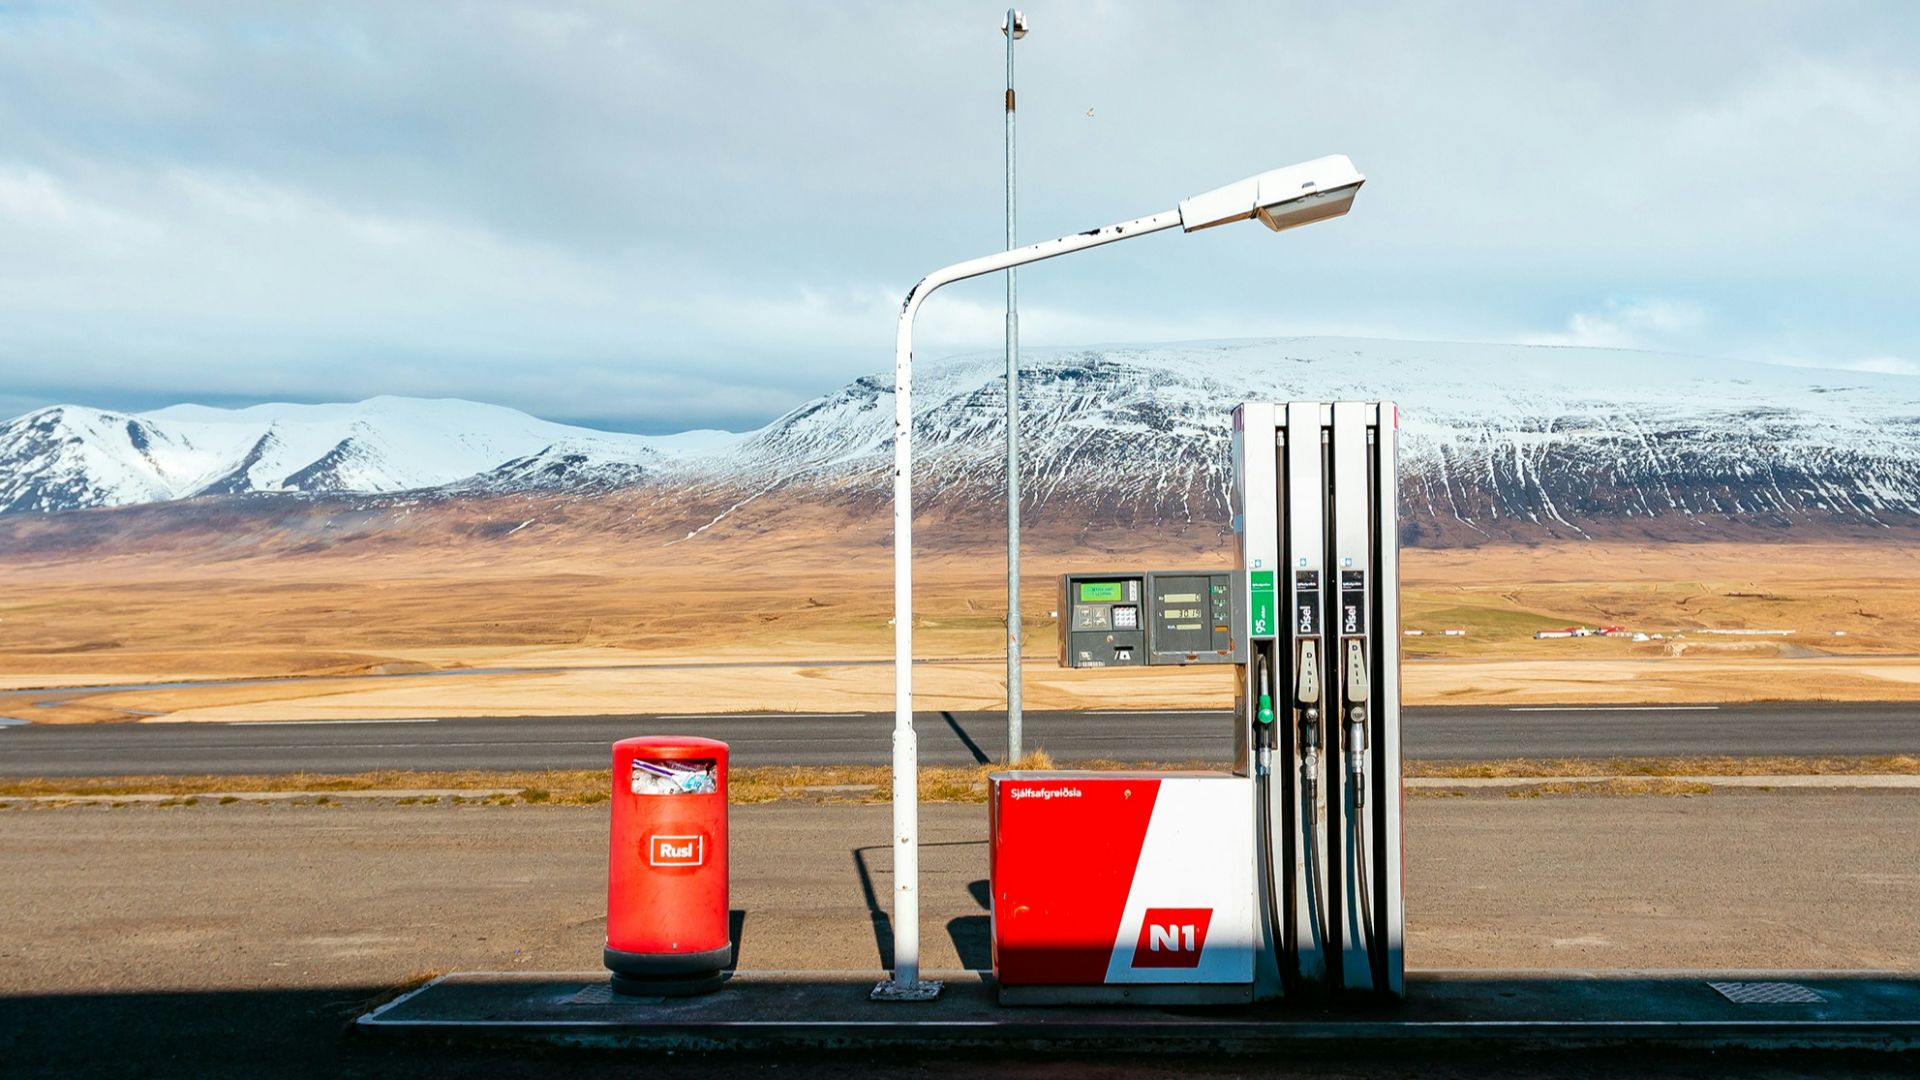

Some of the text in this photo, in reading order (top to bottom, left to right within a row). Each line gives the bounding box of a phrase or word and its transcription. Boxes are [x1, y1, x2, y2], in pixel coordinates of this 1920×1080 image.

[1255, 619, 1266, 634] 95
[1300, 605, 1312, 633] Dísel
[1344, 605, 1357, 633] Dísel
[660, 843, 693, 858] Rusl
[1149, 924, 1195, 952] N1
